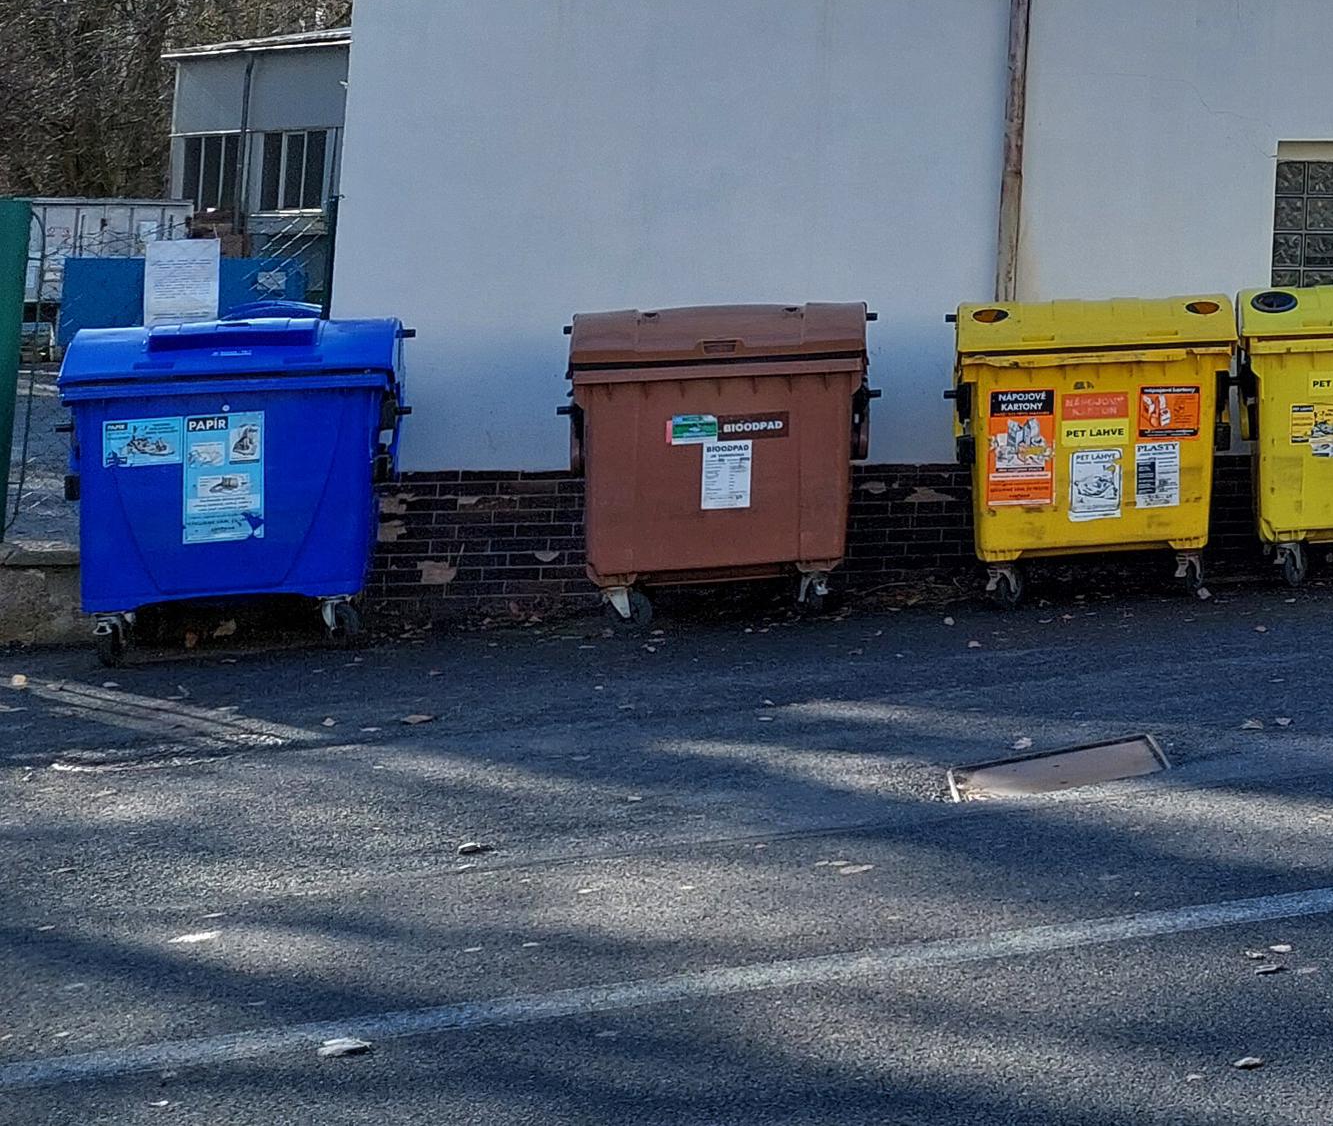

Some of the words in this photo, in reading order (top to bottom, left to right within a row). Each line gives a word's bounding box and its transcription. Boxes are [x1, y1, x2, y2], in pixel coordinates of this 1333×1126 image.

[1312, 380, 1331, 388] PET
[998, 391, 1047, 402] NÁPOJOVÉ
[1000, 402, 1043, 411] KARTONY
[188, 417, 227, 431] PAPÍR
[723, 420, 783, 433] BIOODPAD
[1066, 430, 1087, 438] PET
[1089, 428, 1125, 437] LAHVE
[706, 444, 750, 453] BIOODPAD
[1137, 443, 1178, 452] PLASTY
